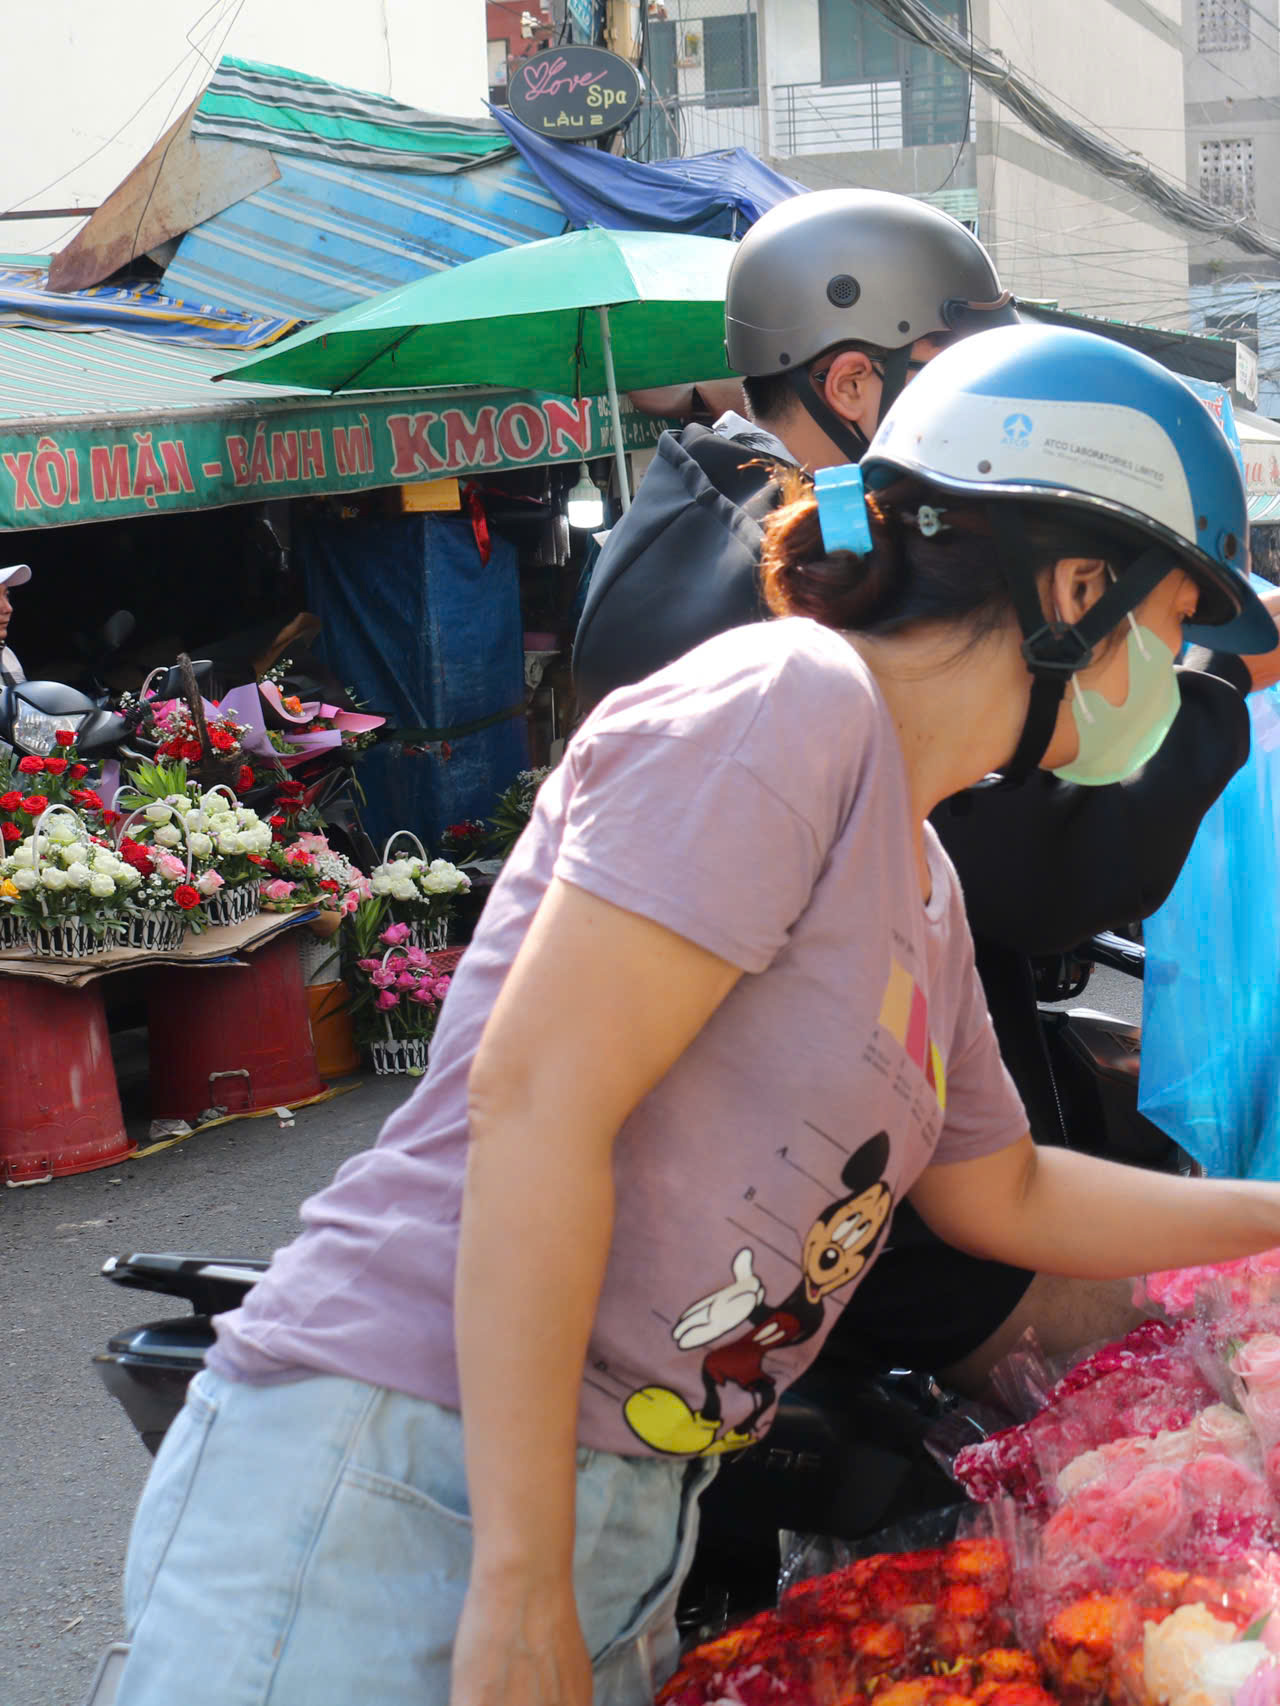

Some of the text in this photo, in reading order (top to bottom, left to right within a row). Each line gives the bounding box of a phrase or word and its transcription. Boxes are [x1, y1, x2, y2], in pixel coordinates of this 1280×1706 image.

[586, 84, 628, 109] Spa
[590, 114, 603, 126] 2
[386, 397, 592, 477] KMON
[1001, 437, 1029, 448] ATCO
[2, 436, 80, 511] XÔI
[90, 432, 195, 509] MẶN
[226, 421, 327, 487] BÁNH
[333, 413, 374, 476] MÌ
[1044, 438, 1068, 450] ATCO
[1070, 444, 1133, 471] LABORATORIES
[1134, 463, 1165, 483] LIMITED
[743, 1186, 756, 1201] B
